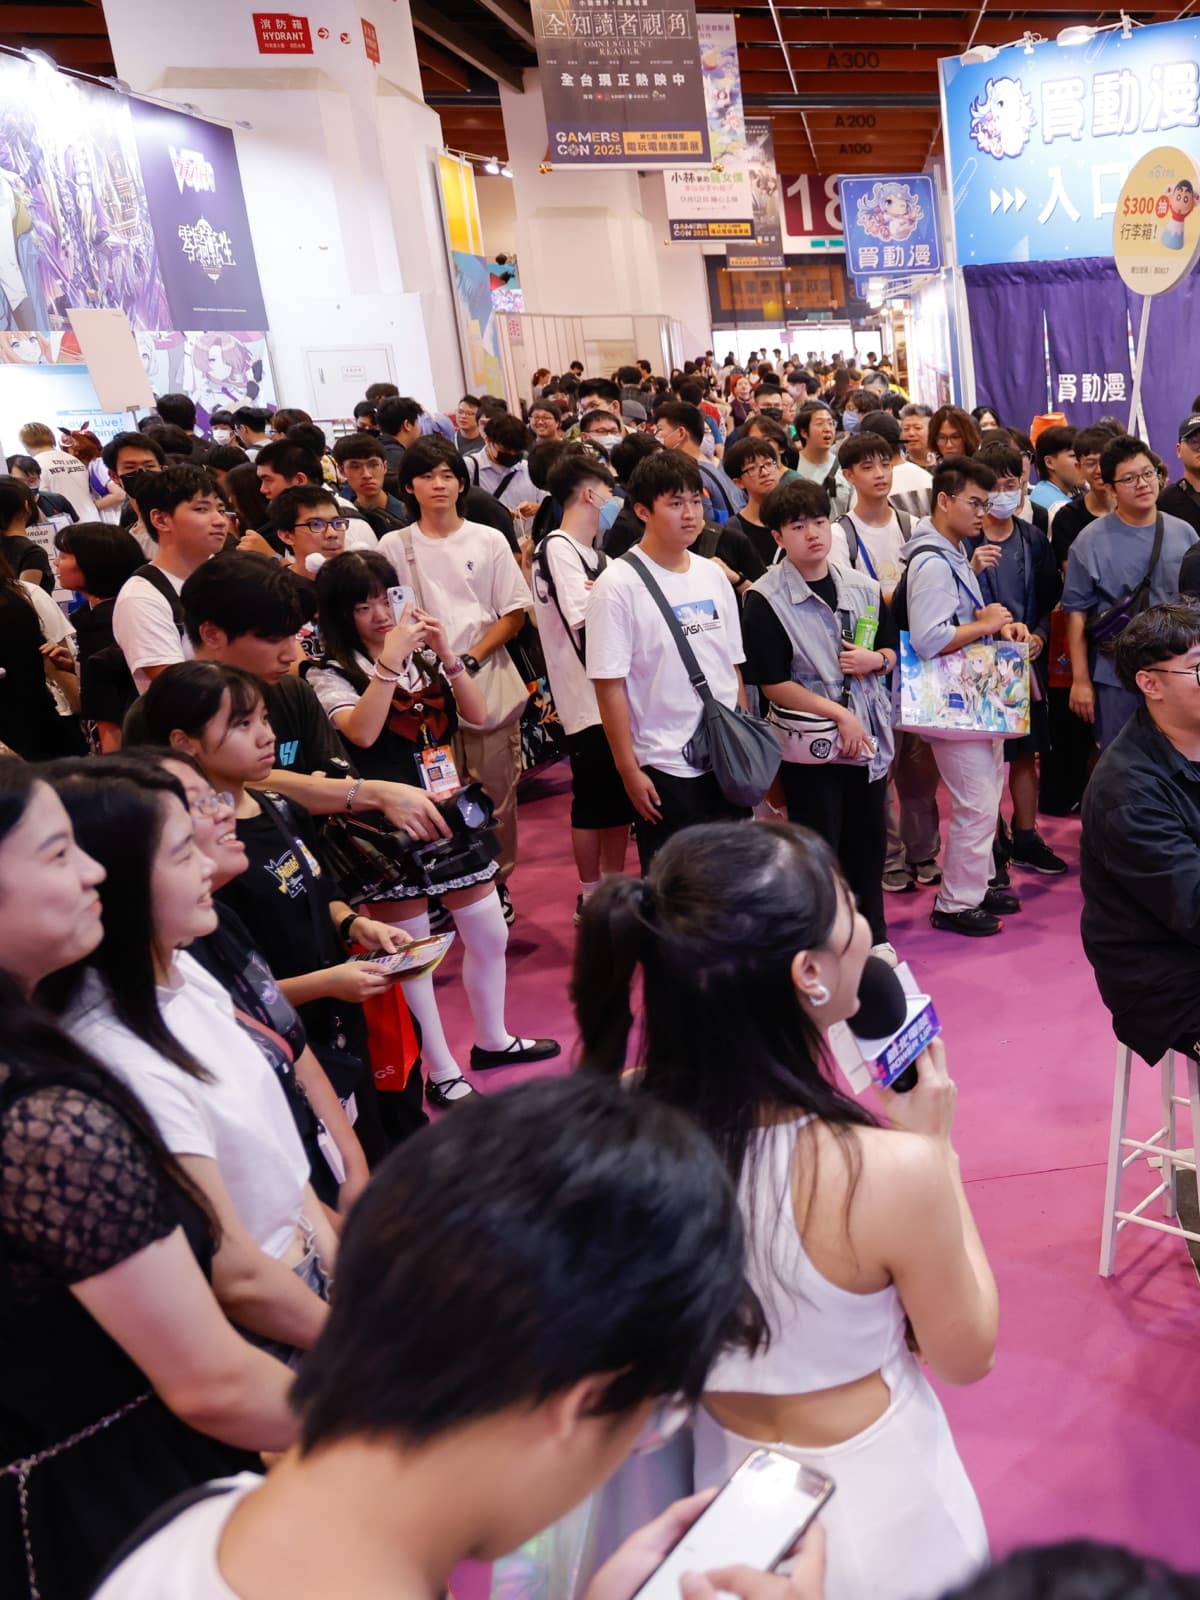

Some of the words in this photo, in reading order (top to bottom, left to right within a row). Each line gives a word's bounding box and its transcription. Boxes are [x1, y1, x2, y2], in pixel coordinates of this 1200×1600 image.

[260, 18, 303, 30] 消防箱
[545, 13, 687, 37] 全知讀者視角
[263, 32, 304, 41] HYDRANT
[599, 48, 640, 56] READER
[826, 51, 880, 70] A300
[560, 72, 685, 88] 全台現正熱映中
[1040, 60, 1200, 143] 買動漫
[834, 114, 877, 128] A200
[556, 131, 621, 143] GAMERS
[594, 144, 622, 155] 2025
[839, 143, 872, 155] A100
[1037, 162, 1129, 226] 入口
[1123, 196, 1154, 216] $300
[858, 244, 931, 269] 買動漫
[1057, 373, 1127, 404] 買動漫
[889, 1041, 920, 1075] POWER
[919, 1024, 933, 1046] UP
